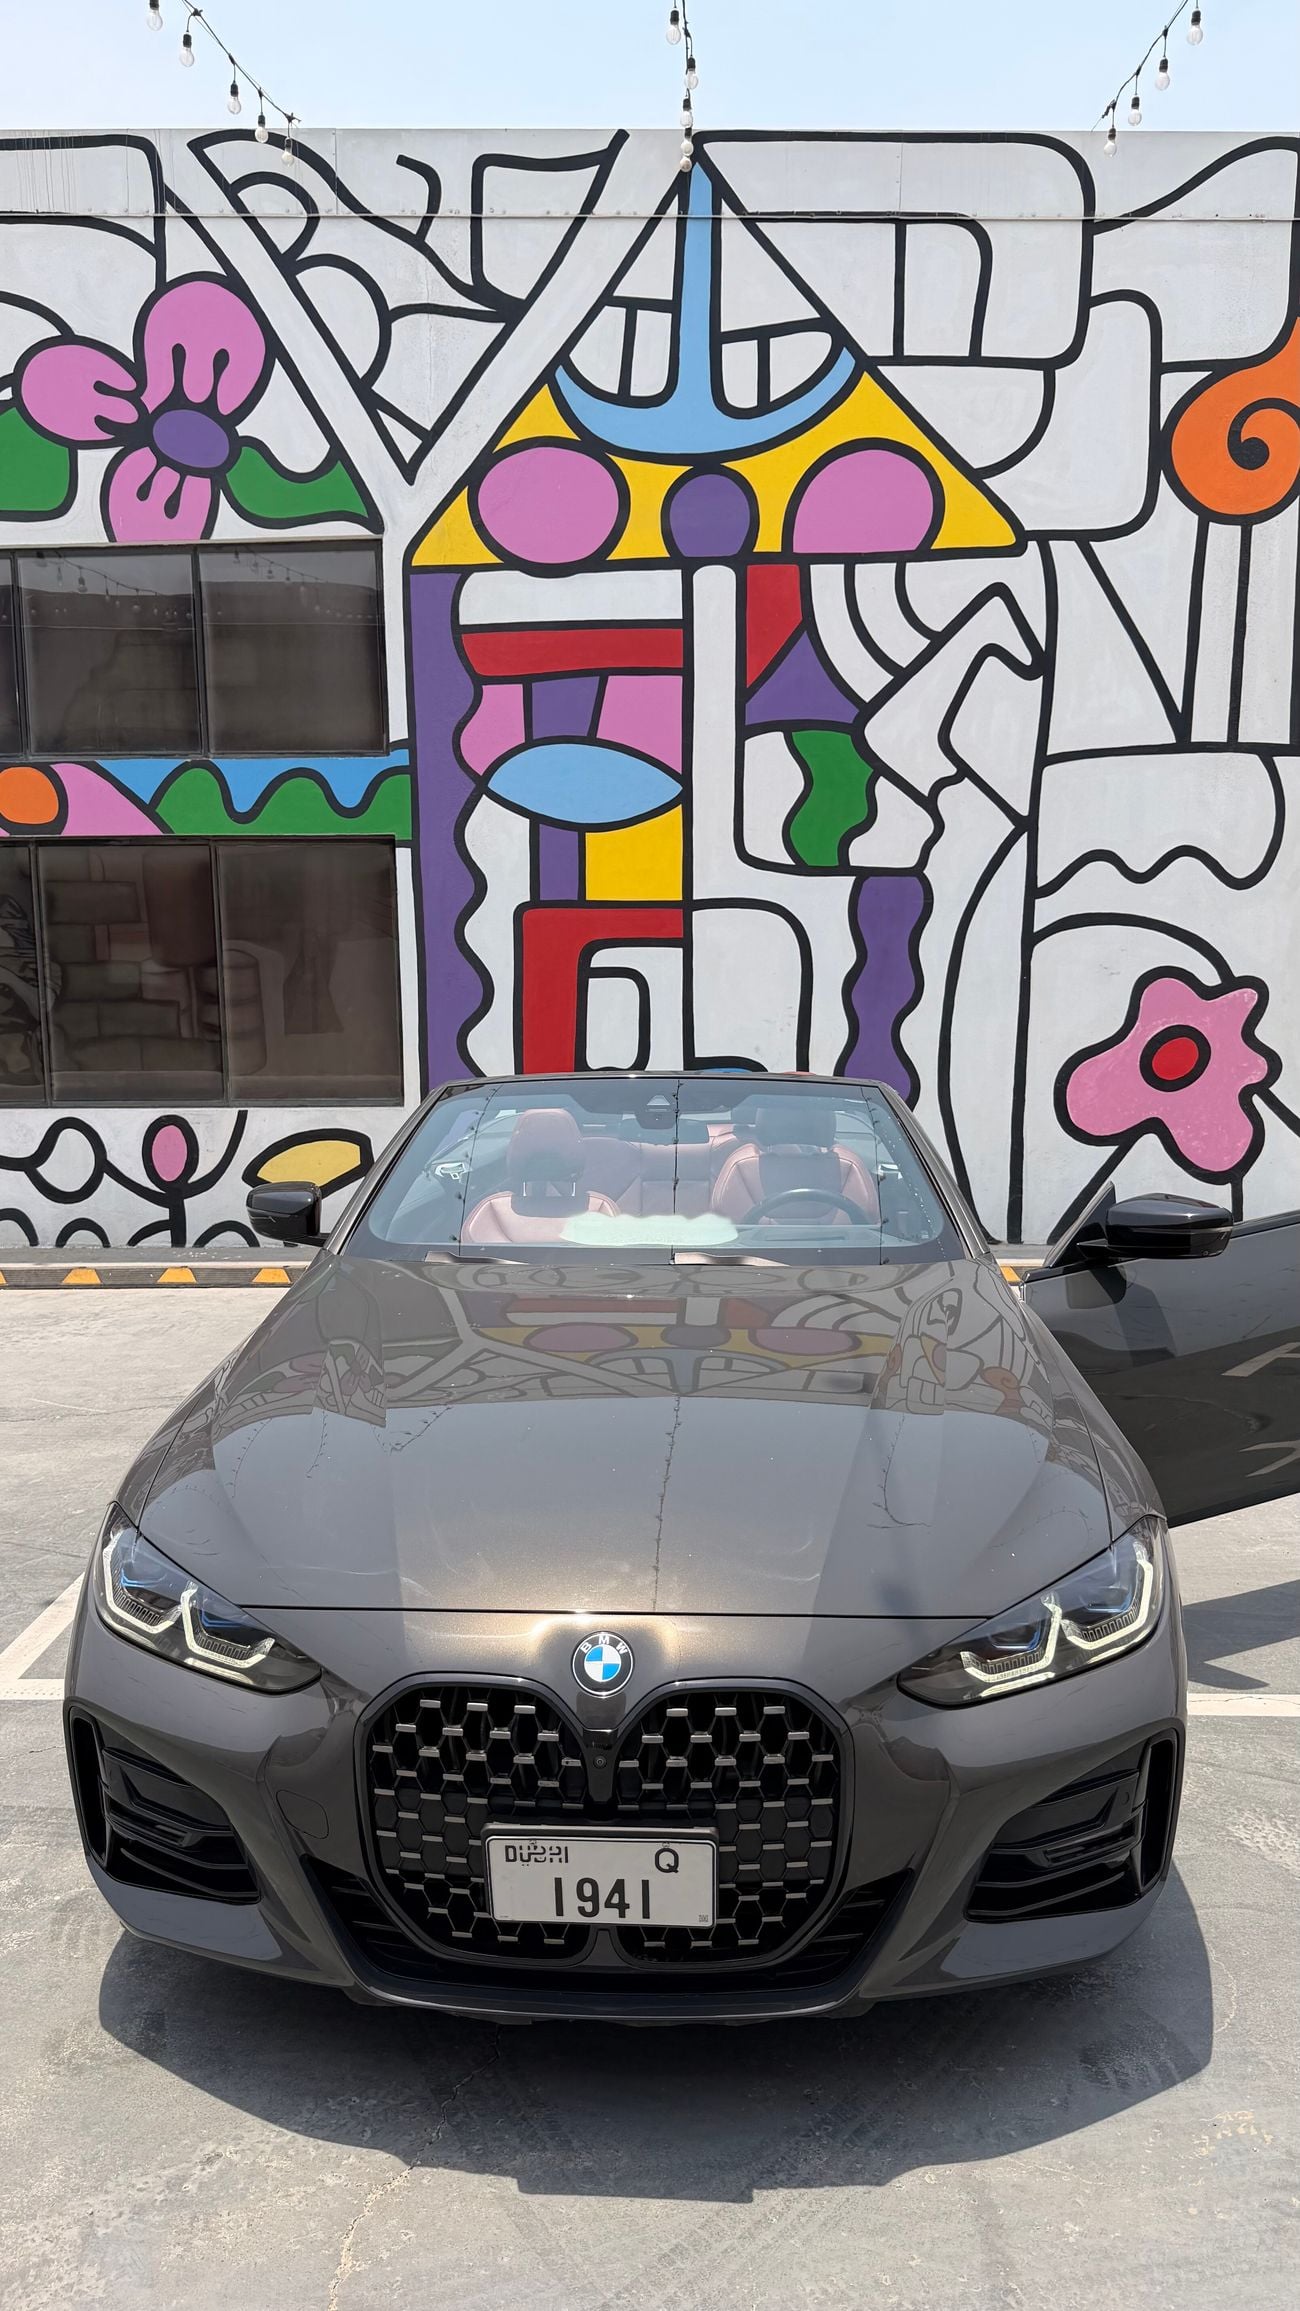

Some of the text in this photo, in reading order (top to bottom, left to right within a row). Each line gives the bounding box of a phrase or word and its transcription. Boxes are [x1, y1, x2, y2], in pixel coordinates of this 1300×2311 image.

[580, 1635, 628, 1654] BMW
[505, 1844, 679, 1873] DUBAI Q
[554, 1877, 650, 1919] 1941
